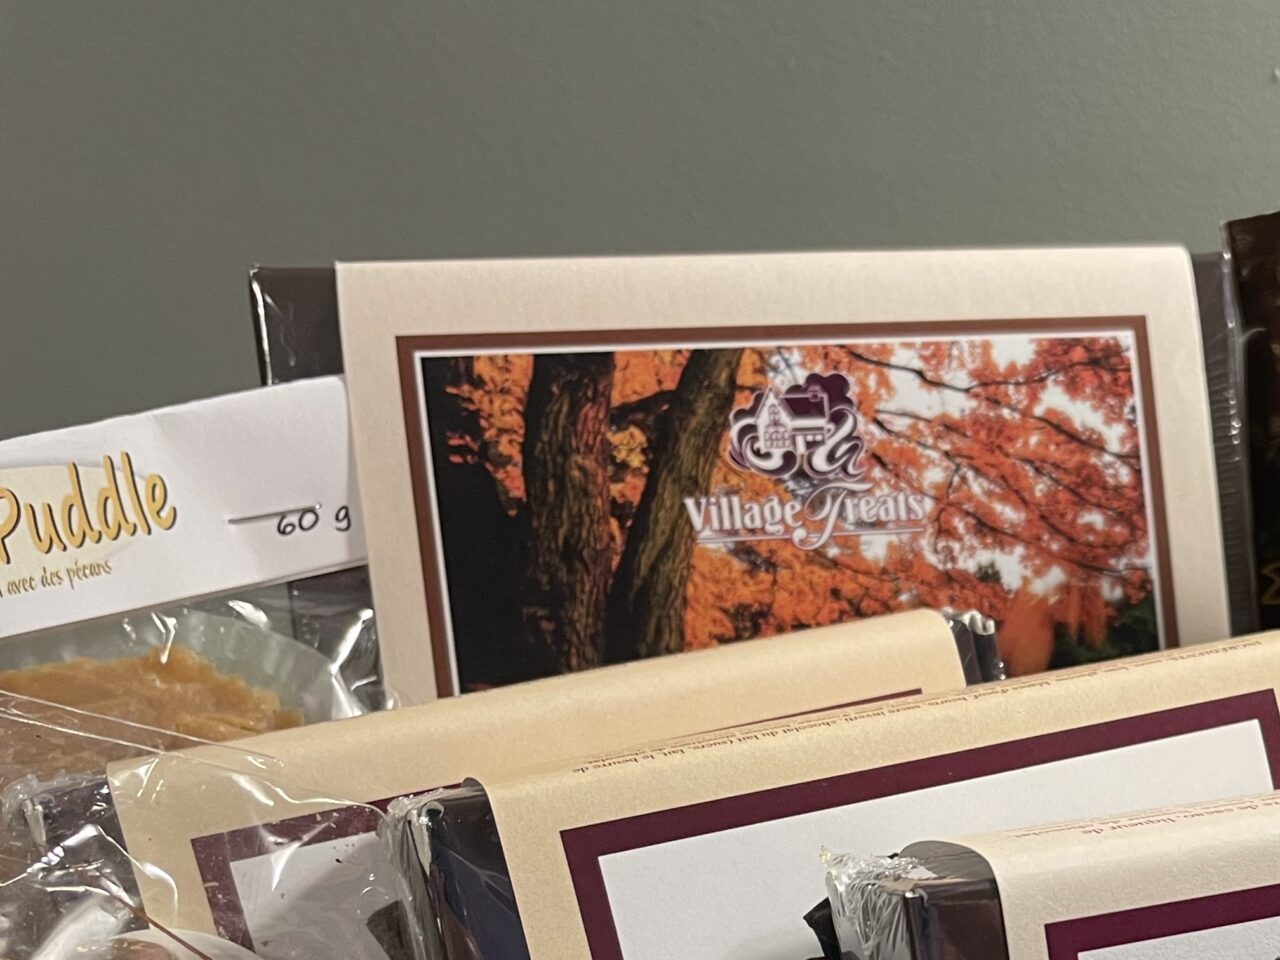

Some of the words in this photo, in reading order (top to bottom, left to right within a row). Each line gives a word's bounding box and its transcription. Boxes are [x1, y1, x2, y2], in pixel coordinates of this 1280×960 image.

[0, 451, 177, 565] Puddle
[277, 508, 319, 536] 60
[334, 504, 351, 533] g
[684, 494, 802, 537] Village
[792, 480, 926, 550] Treats
[7, 575, 36, 596] avec
[41, 565, 63, 588] des
[66, 558, 113, 590] pécans
